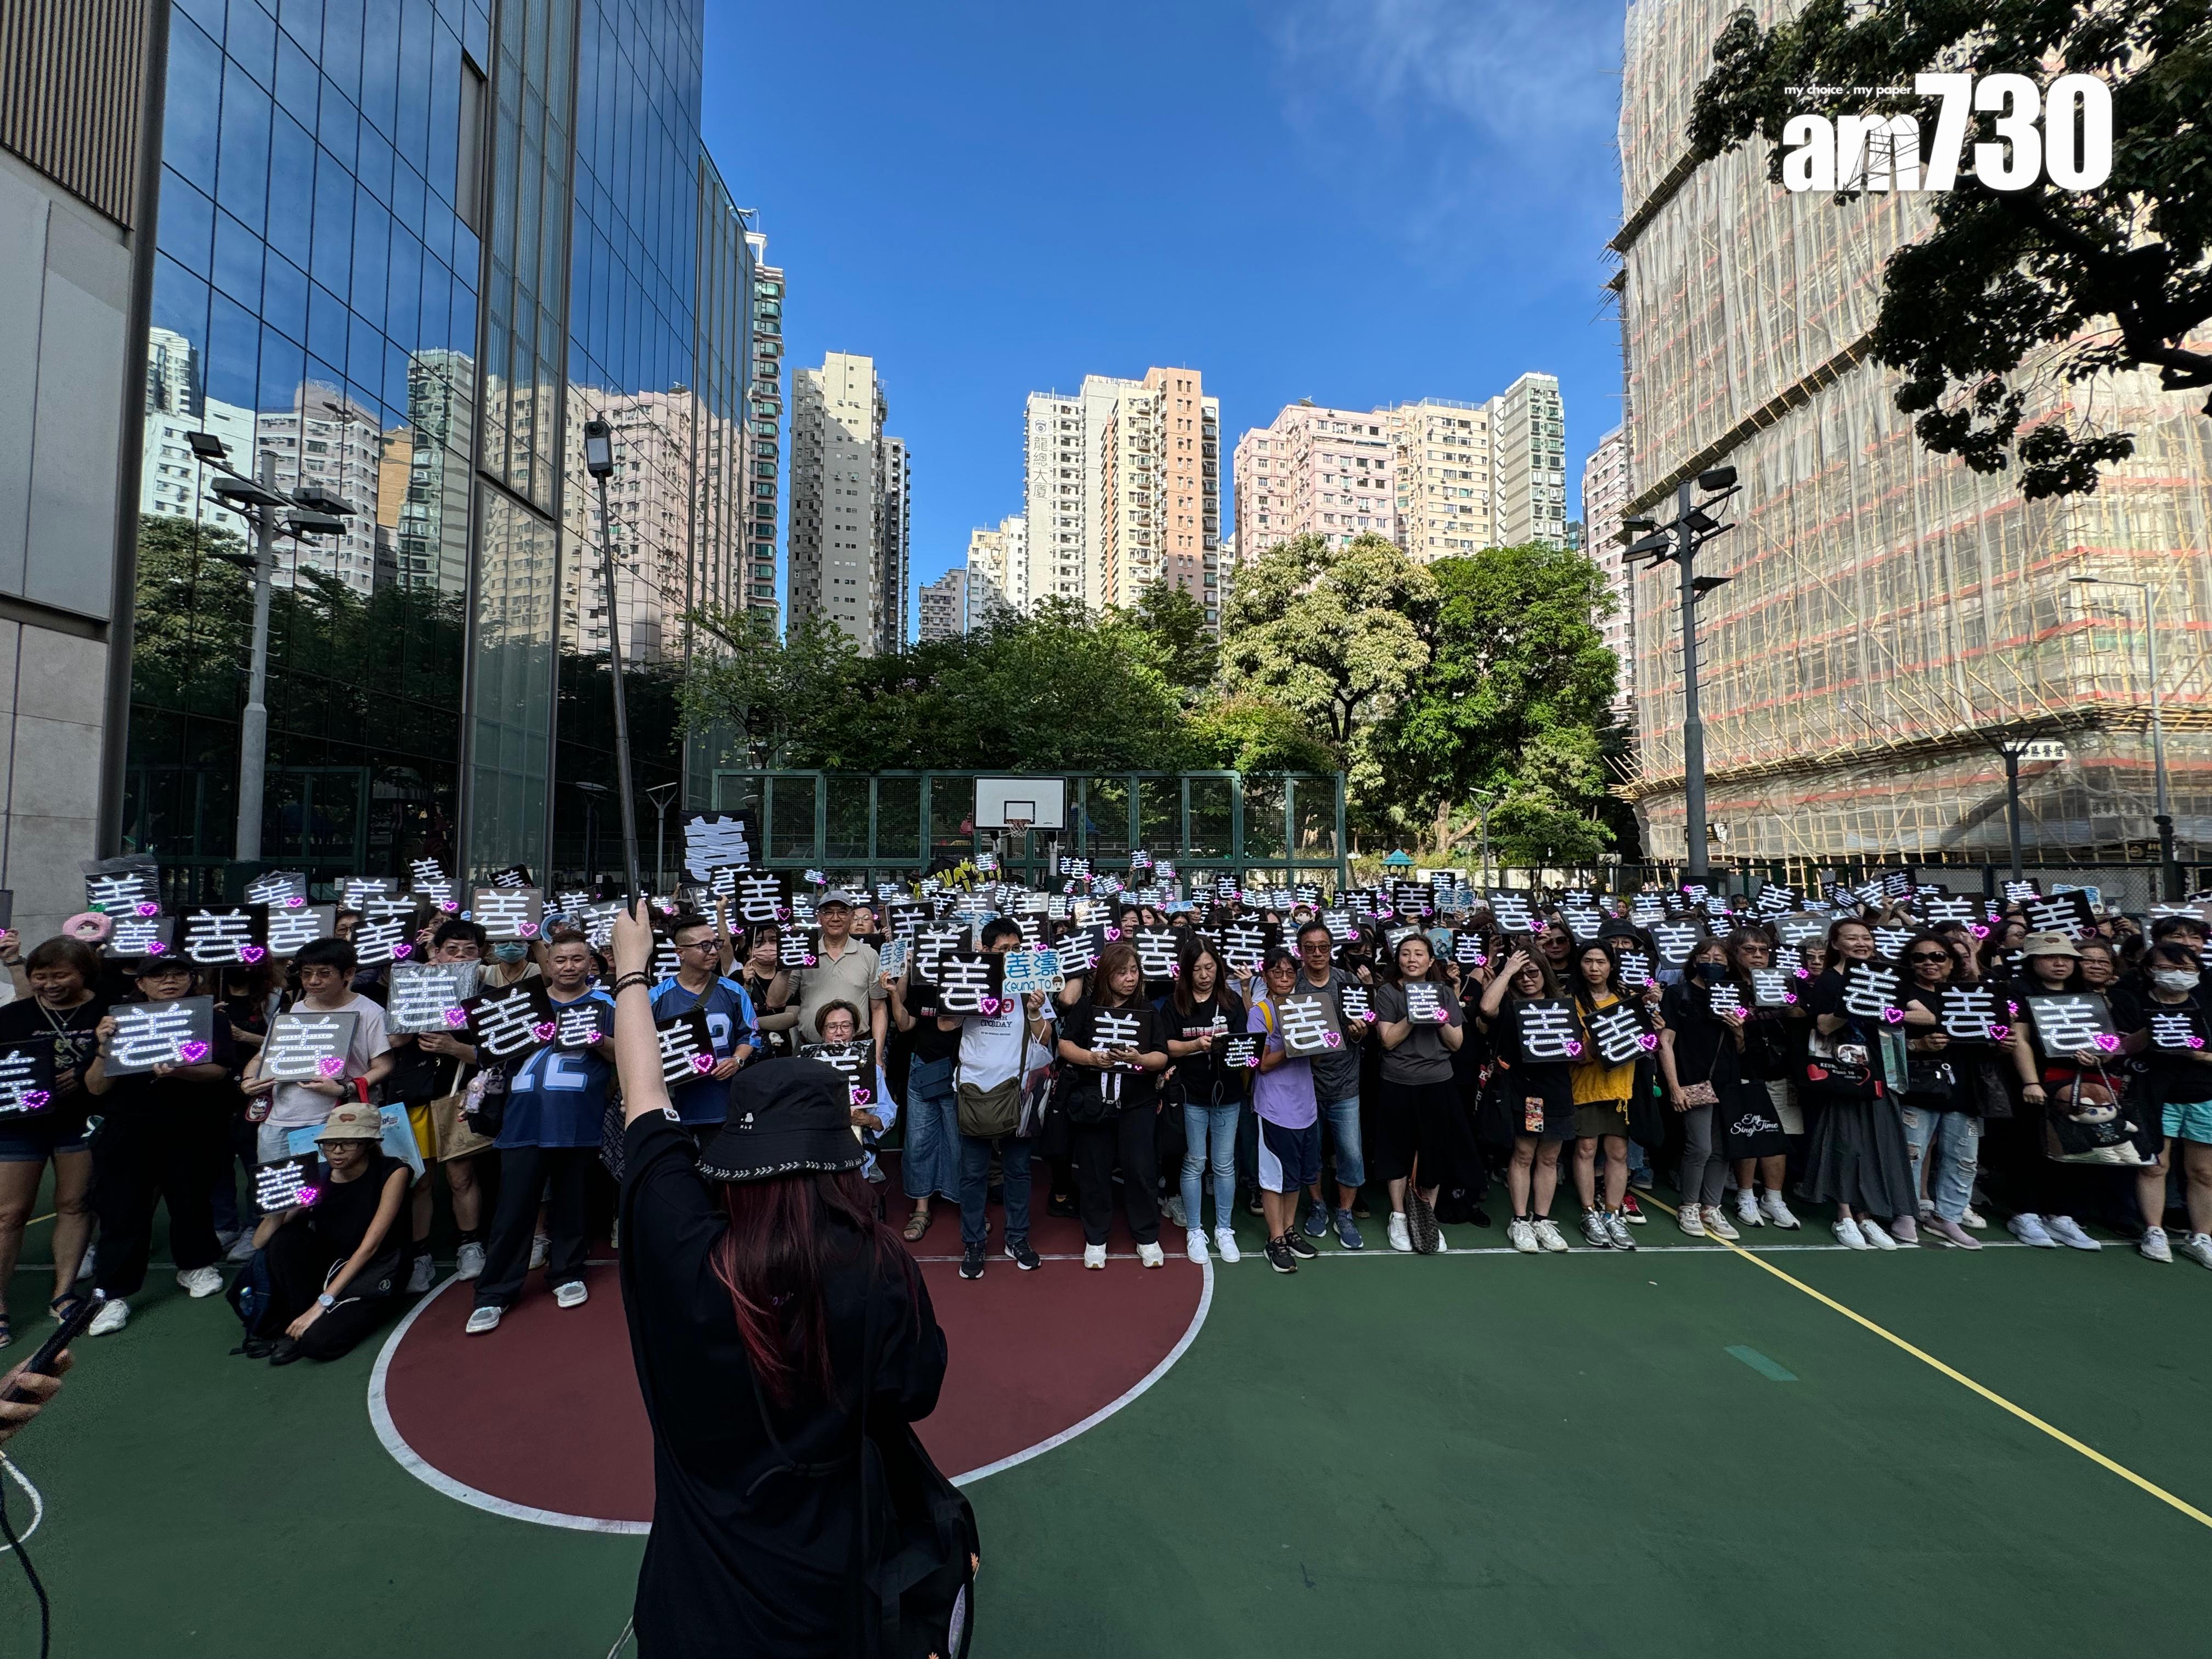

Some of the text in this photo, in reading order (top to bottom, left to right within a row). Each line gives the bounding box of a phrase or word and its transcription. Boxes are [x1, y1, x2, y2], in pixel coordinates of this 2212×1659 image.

[1033, 436, 1048, 499] 龍總大廈
[684, 815, 749, 882] 姜
[1071, 858, 1090, 878] 姜
[1131, 849, 1148, 868] 姜
[88, 873, 145, 918] 姜
[740, 874, 782, 921] 姜
[1218, 877, 1237, 898] 姜
[1396, 884, 1429, 916] 姜
[267, 909, 321, 952] 姜
[473, 890, 529, 936] 姜
[1491, 893, 1534, 932] 姜
[110, 919, 159, 953] 姜
[184, 909, 252, 962] 姜
[354, 917, 406, 964] 姜
[780, 933, 809, 966] 姜
[1056, 930, 1094, 973] 姜
[1136, 928, 1178, 978] 姜
[1222, 924, 1266, 972] 姜
[1455, 933, 1482, 964] 姜
[940, 956, 990, 1012] 姜
[1006, 950, 1059, 978] 姜濤
[1620, 952, 1650, 985] 姜
[391, 969, 458, 1026] 姜
[1005, 981, 1035, 992] Keung
[1342, 986, 1370, 1019] 姜
[1408, 984, 1440, 1019] 姜
[1710, 983, 1741, 1014] 姜
[1754, 970, 1790, 1003] 姜
[1842, 963, 1900, 1021] 姜
[111, 1002, 193, 1066] 姜
[471, 988, 541, 1054] 姜
[558, 1006, 598, 1046] 姜
[980, 1019, 1013, 1028] (TO)DAY
[1279, 996, 1329, 1049] 姜
[1520, 1002, 1575, 1057] 姜
[1592, 1006, 1645, 1062] 姜
[1940, 986, 1996, 1039] 姜
[2034, 997, 2102, 1050] 姜
[2151, 1013, 2195, 1047] 姜
[265, 1017, 339, 1075] 姜
[1224, 1037, 1256, 1067] 姜
[256, 1161, 305, 1210] 姜
